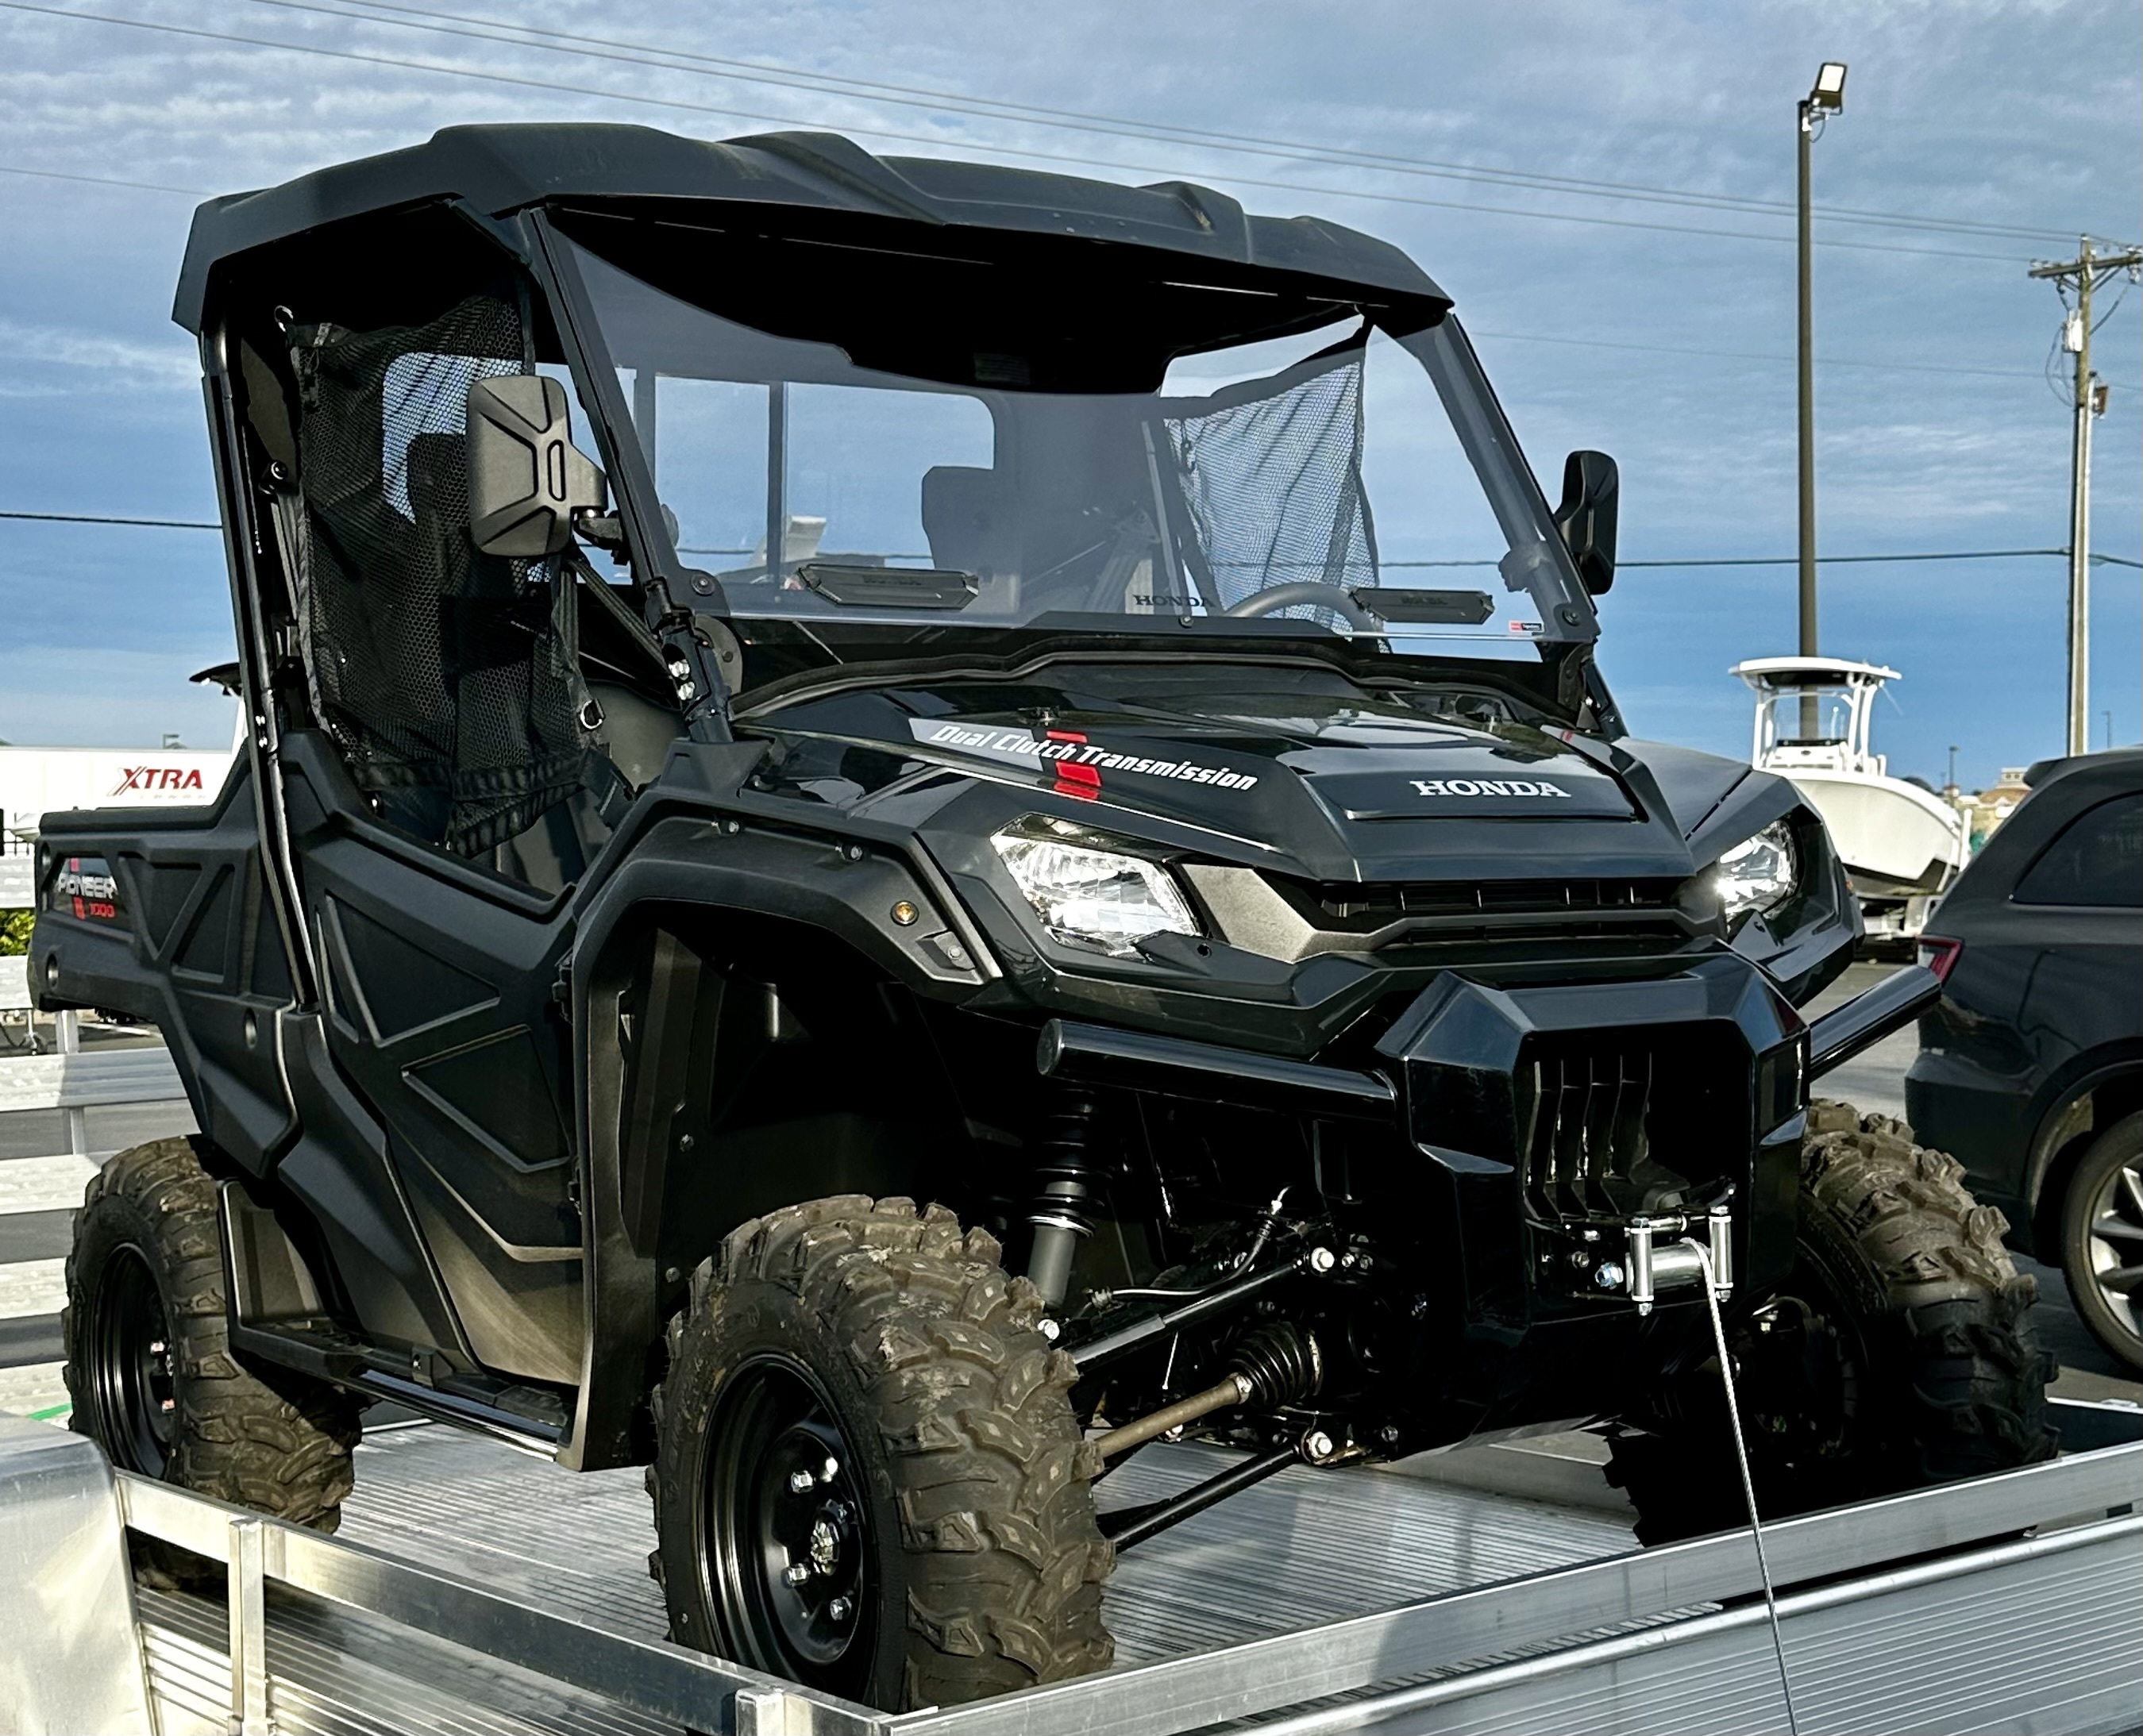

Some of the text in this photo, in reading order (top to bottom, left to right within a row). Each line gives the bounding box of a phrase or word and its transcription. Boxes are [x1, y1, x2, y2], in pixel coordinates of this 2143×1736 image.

[1133, 595, 1216, 607] HONDA
[930, 725, 1258, 791] Dual Clutch Transmission
[113, 766, 202, 796] XTRA
[1409, 779, 1572, 798] HONDA
